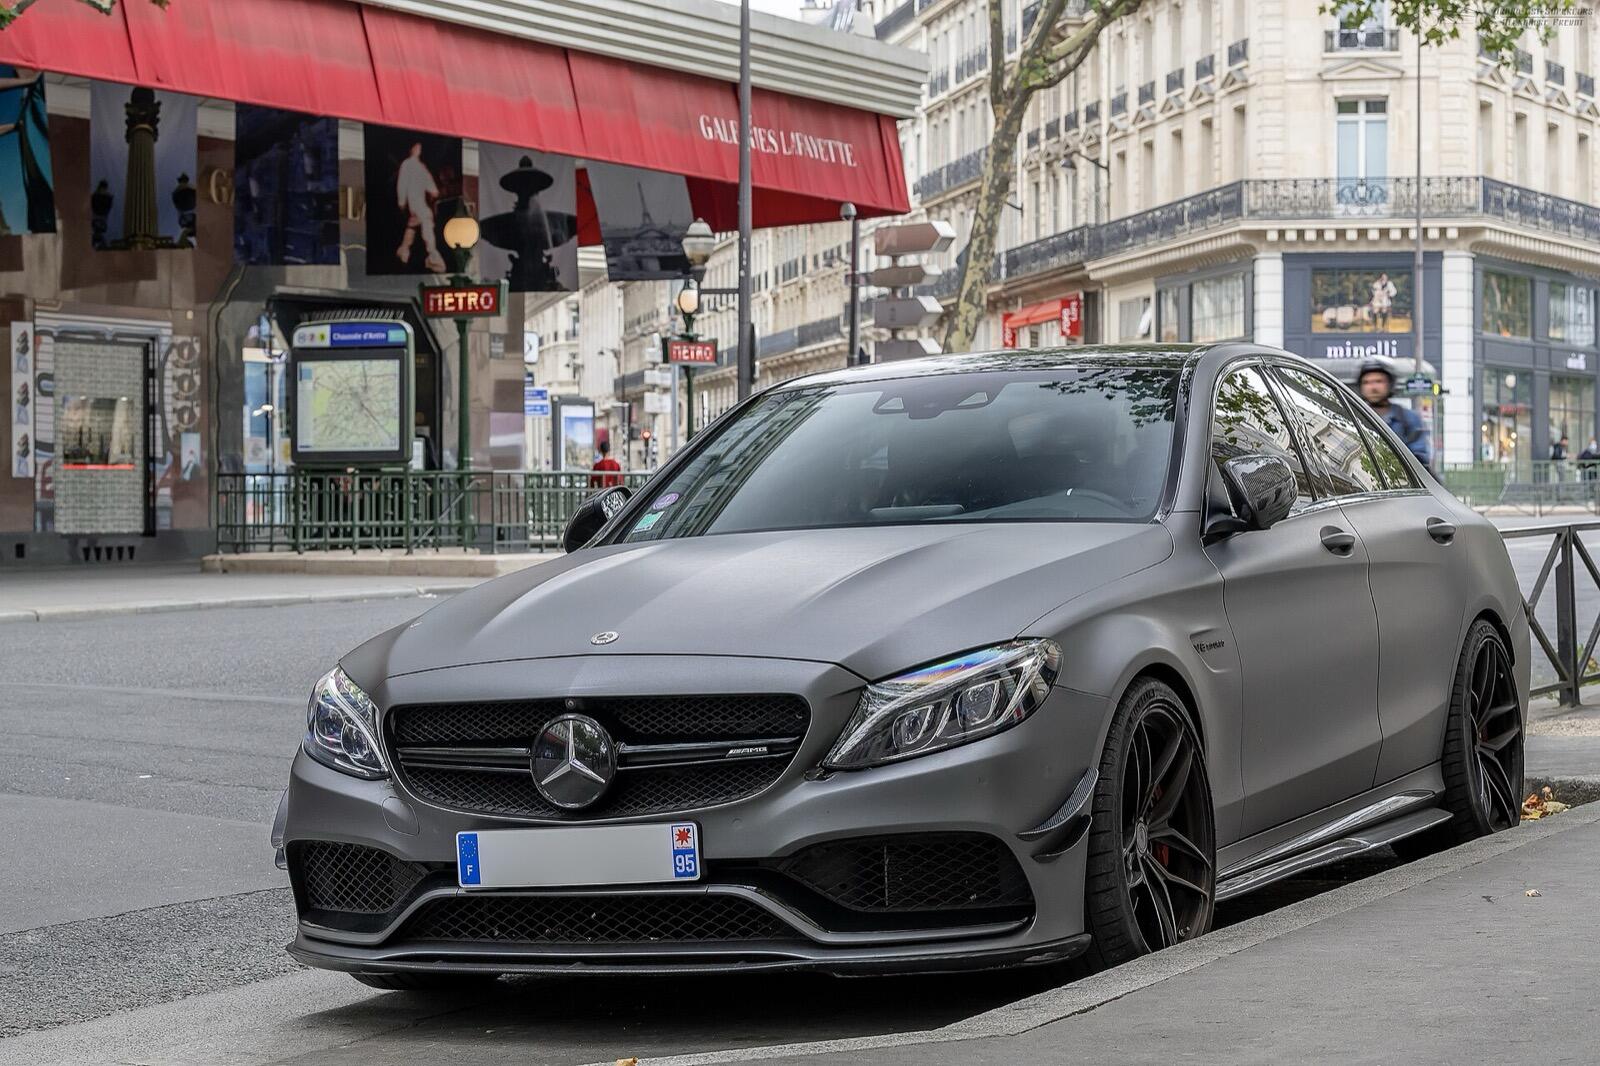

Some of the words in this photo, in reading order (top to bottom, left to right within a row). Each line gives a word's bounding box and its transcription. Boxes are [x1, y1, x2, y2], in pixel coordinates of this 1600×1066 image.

[699, 114, 778, 154] GALEIES
[429, 291, 494, 312] METRO
[672, 344, 712, 361] METRO
[1326, 340, 1398, 358] minelli
[466, 864, 473, 877] F
[675, 853, 695, 873] 95
